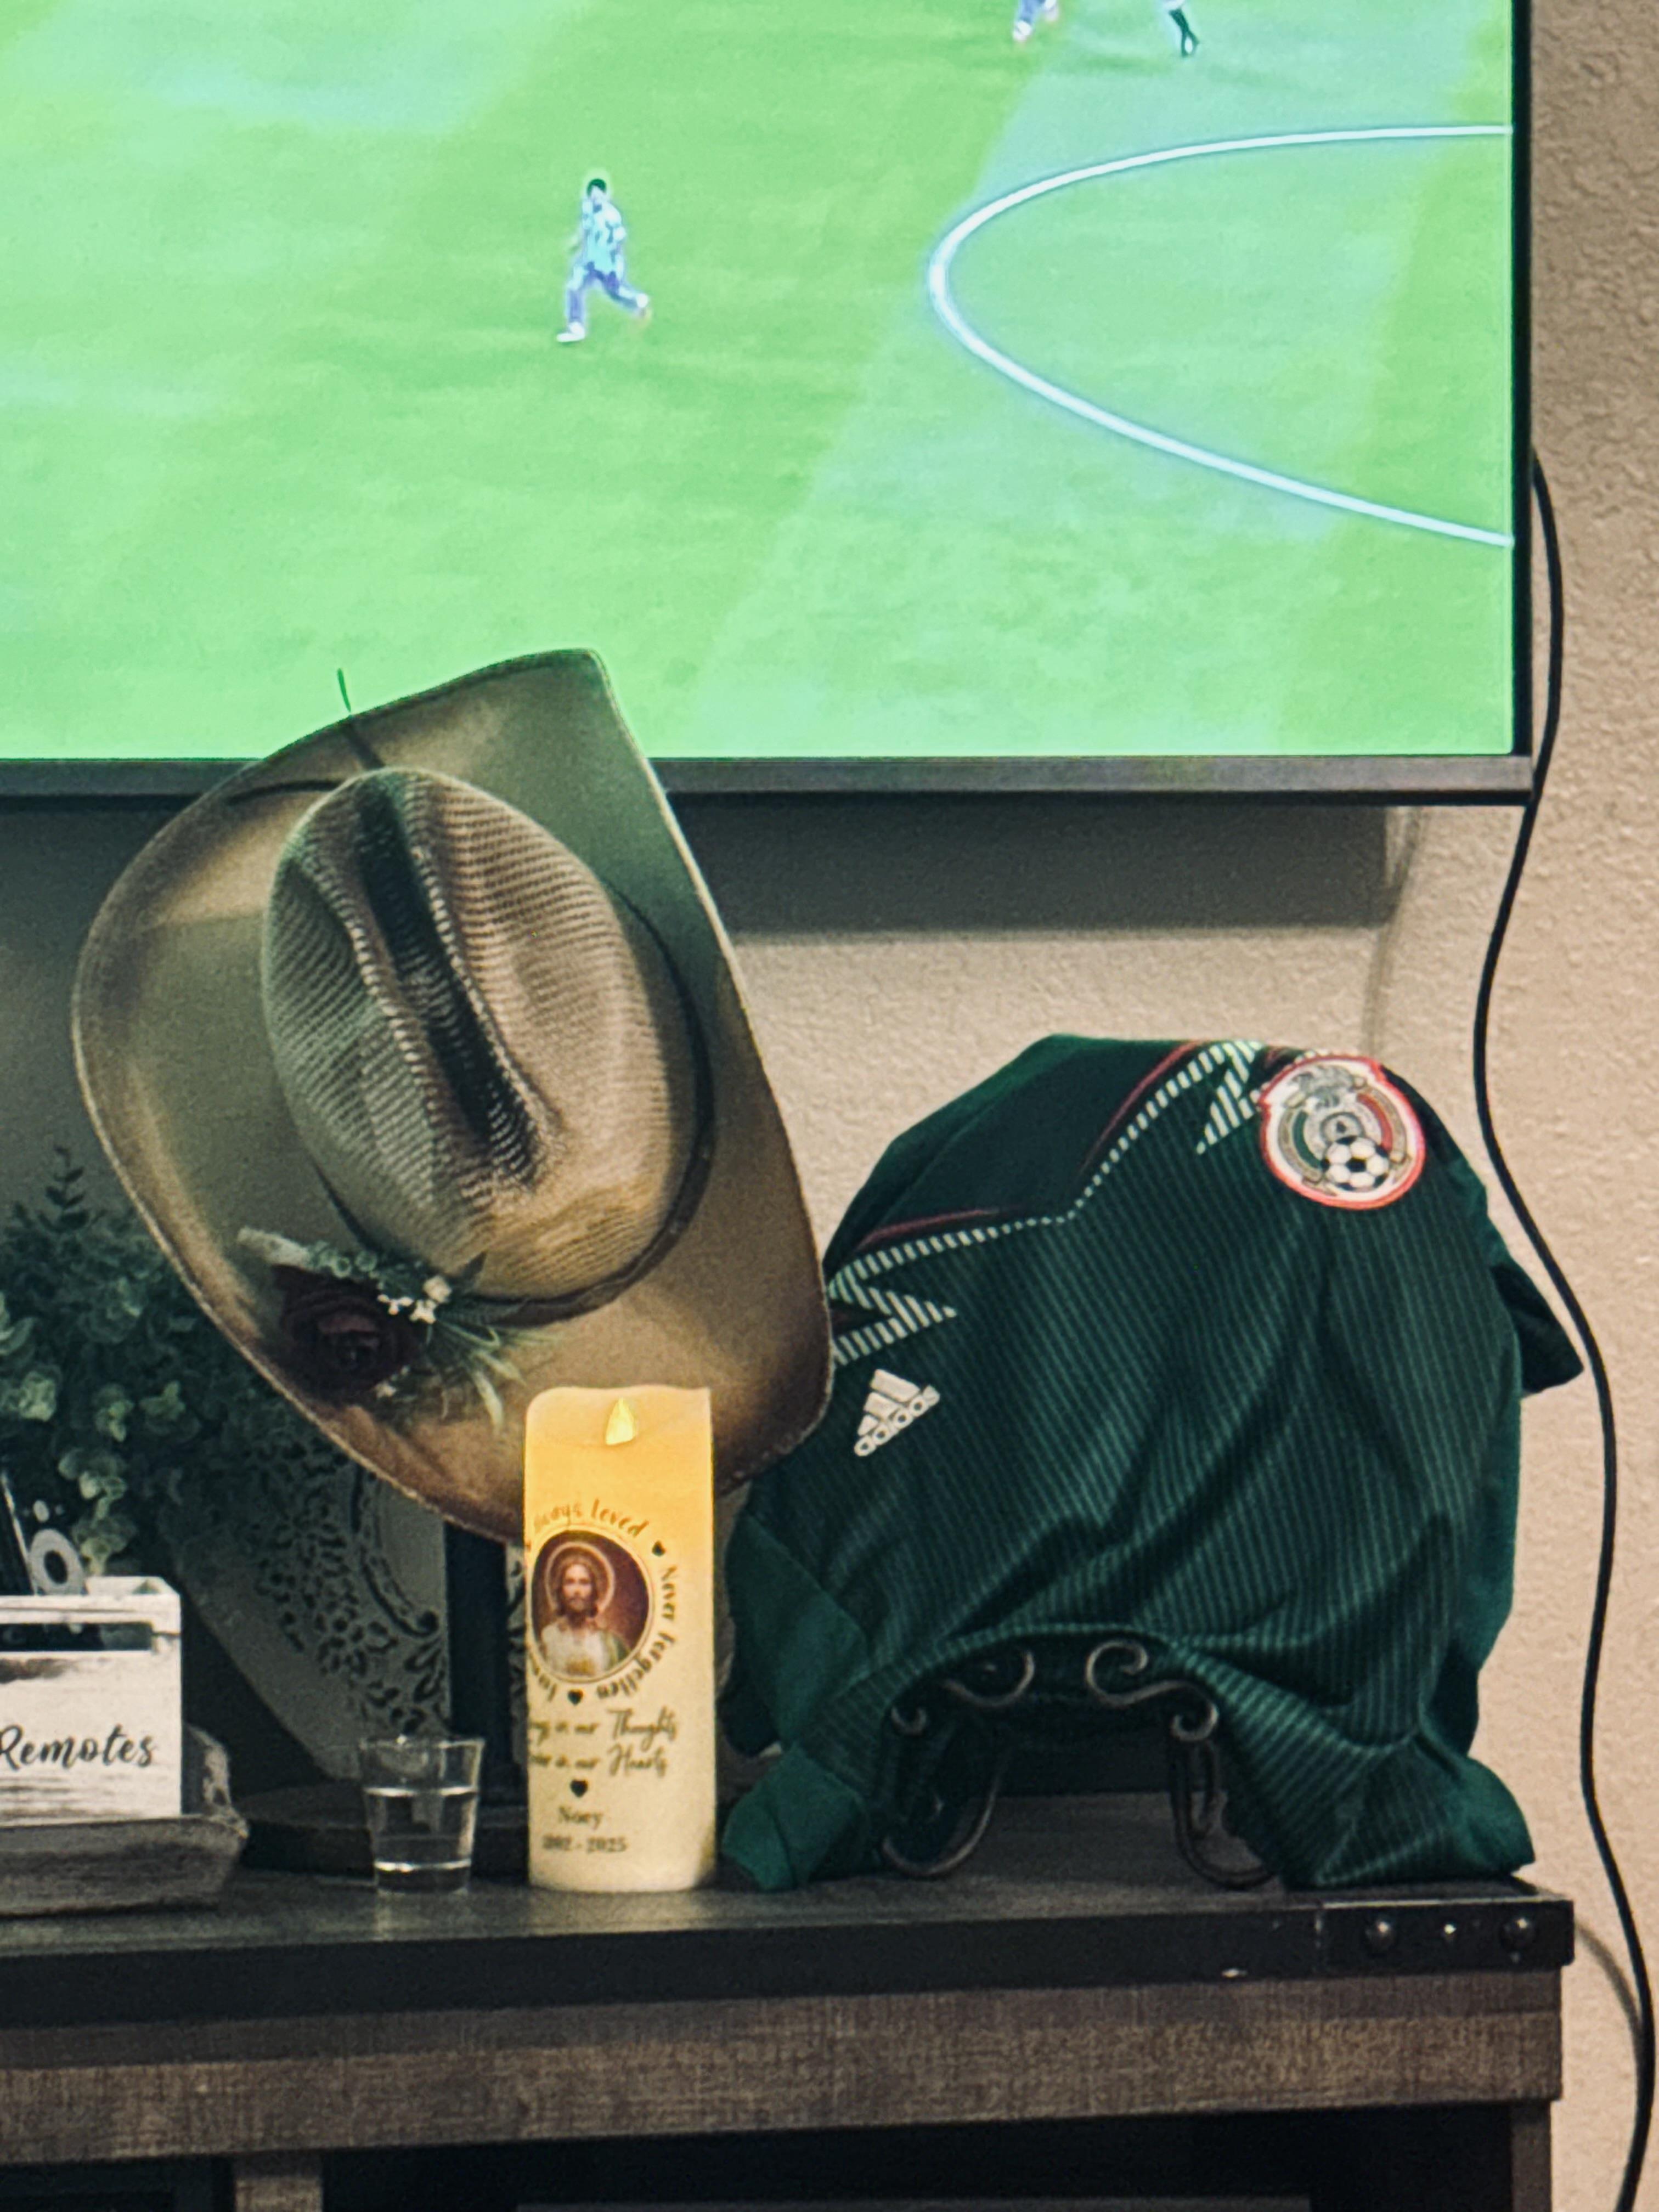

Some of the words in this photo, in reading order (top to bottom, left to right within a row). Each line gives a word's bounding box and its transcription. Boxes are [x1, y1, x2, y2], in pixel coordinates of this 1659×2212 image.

[591, 1498, 650, 1537] loved
[0, 1723, 155, 1771] Remotes
[587, 1835, 627, 1853] 2025
